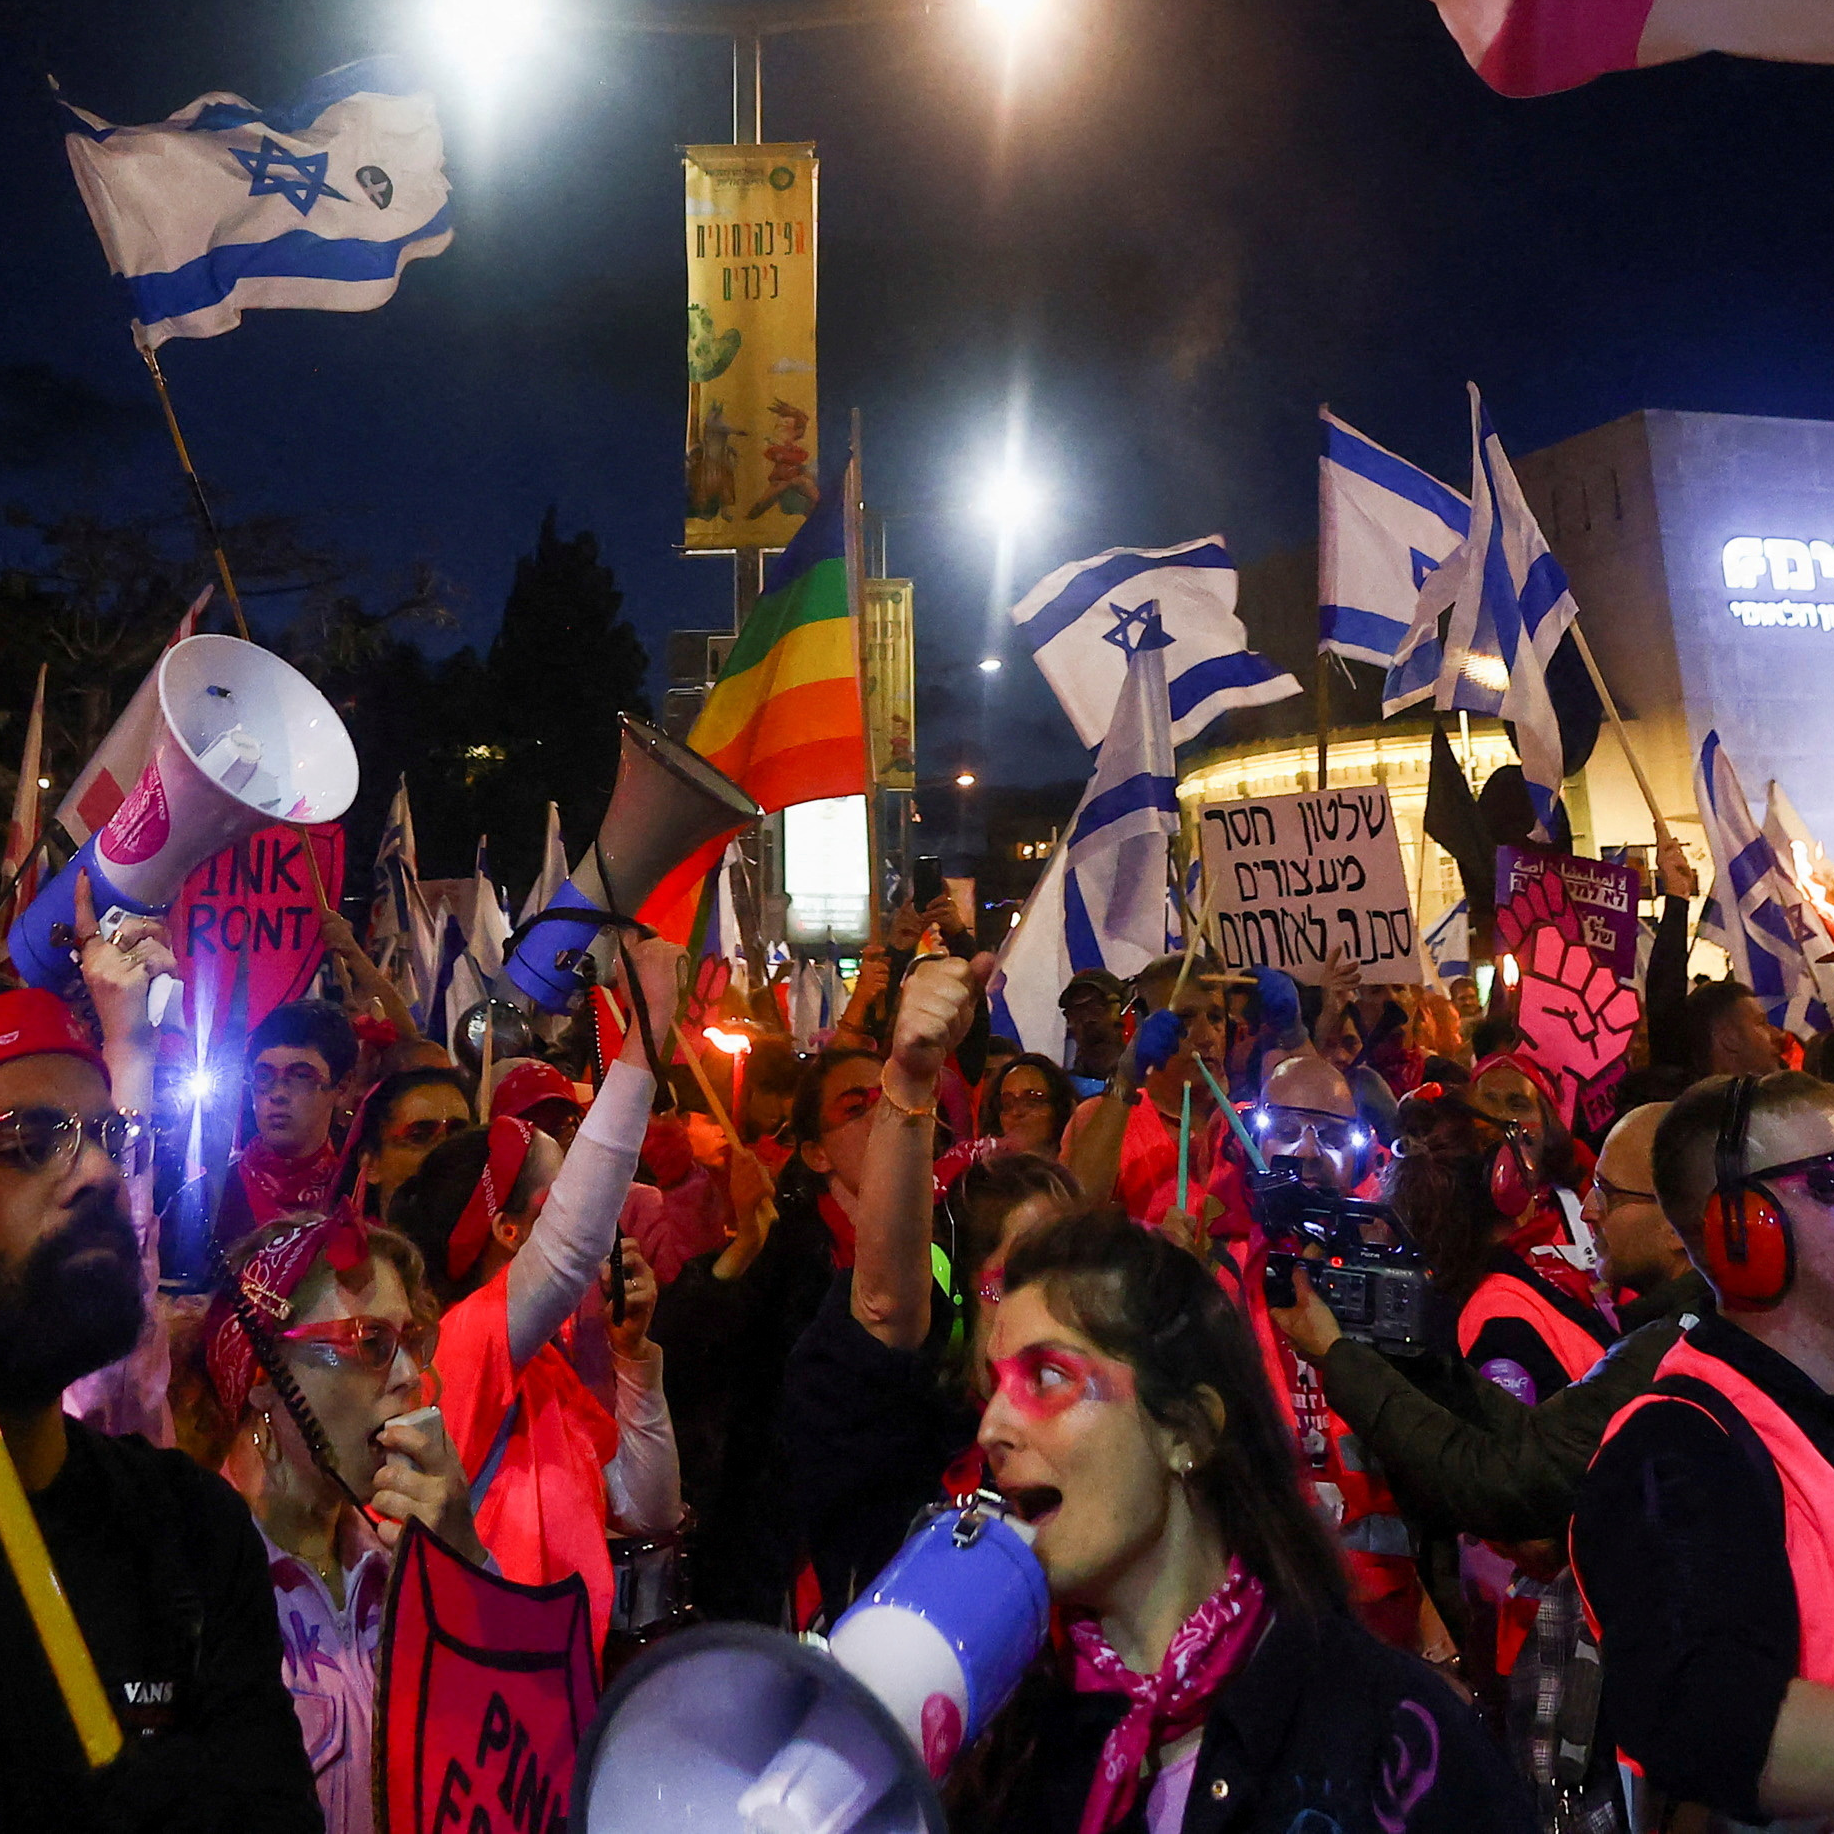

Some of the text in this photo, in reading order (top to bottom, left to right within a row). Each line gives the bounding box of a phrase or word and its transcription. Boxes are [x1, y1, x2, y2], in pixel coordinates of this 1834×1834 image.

[723, 263, 778, 301] לילדים
[1204, 795, 1386, 855] שלטון חסר
[200, 838, 303, 898] INK
[1235, 855, 1366, 901] מעצורים
[187, 905, 312, 958] RONT
[1219, 901, 1412, 968] סכנה לאזרחים
[1587, 1083, 1617, 1124] FRO
[123, 1681, 174, 1704] VANS
